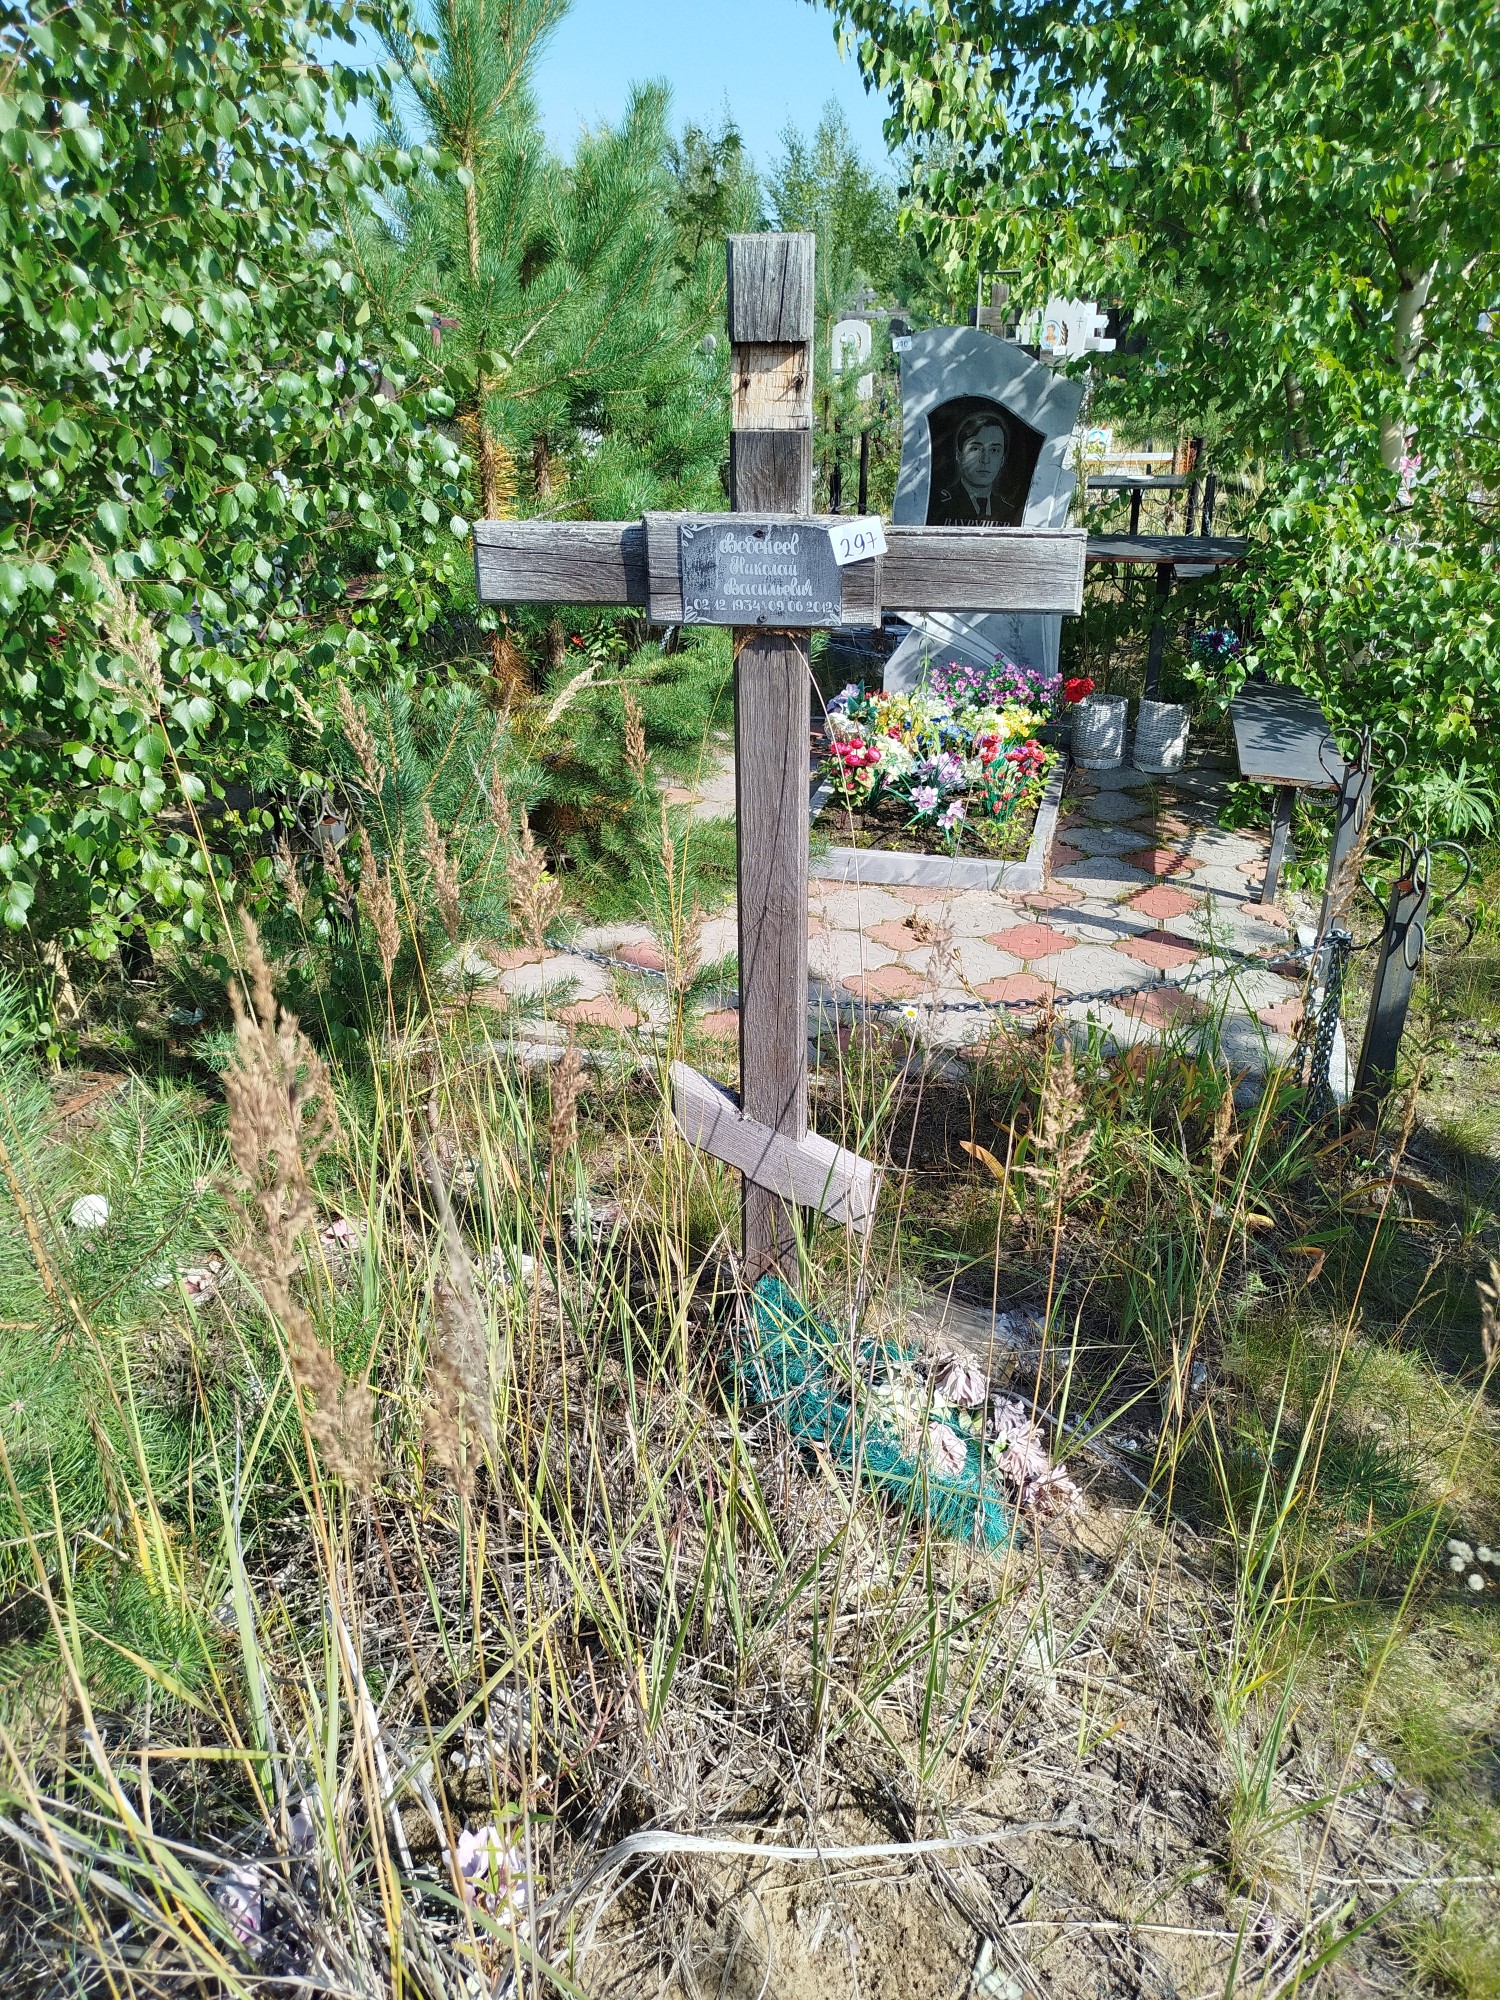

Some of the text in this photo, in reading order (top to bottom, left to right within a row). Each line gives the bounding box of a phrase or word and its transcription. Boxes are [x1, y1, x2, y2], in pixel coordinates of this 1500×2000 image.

[719, 532, 800, 555] Веденеев
[840, 531, 877, 558] 297
[729, 555, 799, 577] Николай
[723, 577, 813, 597] Васильевич
